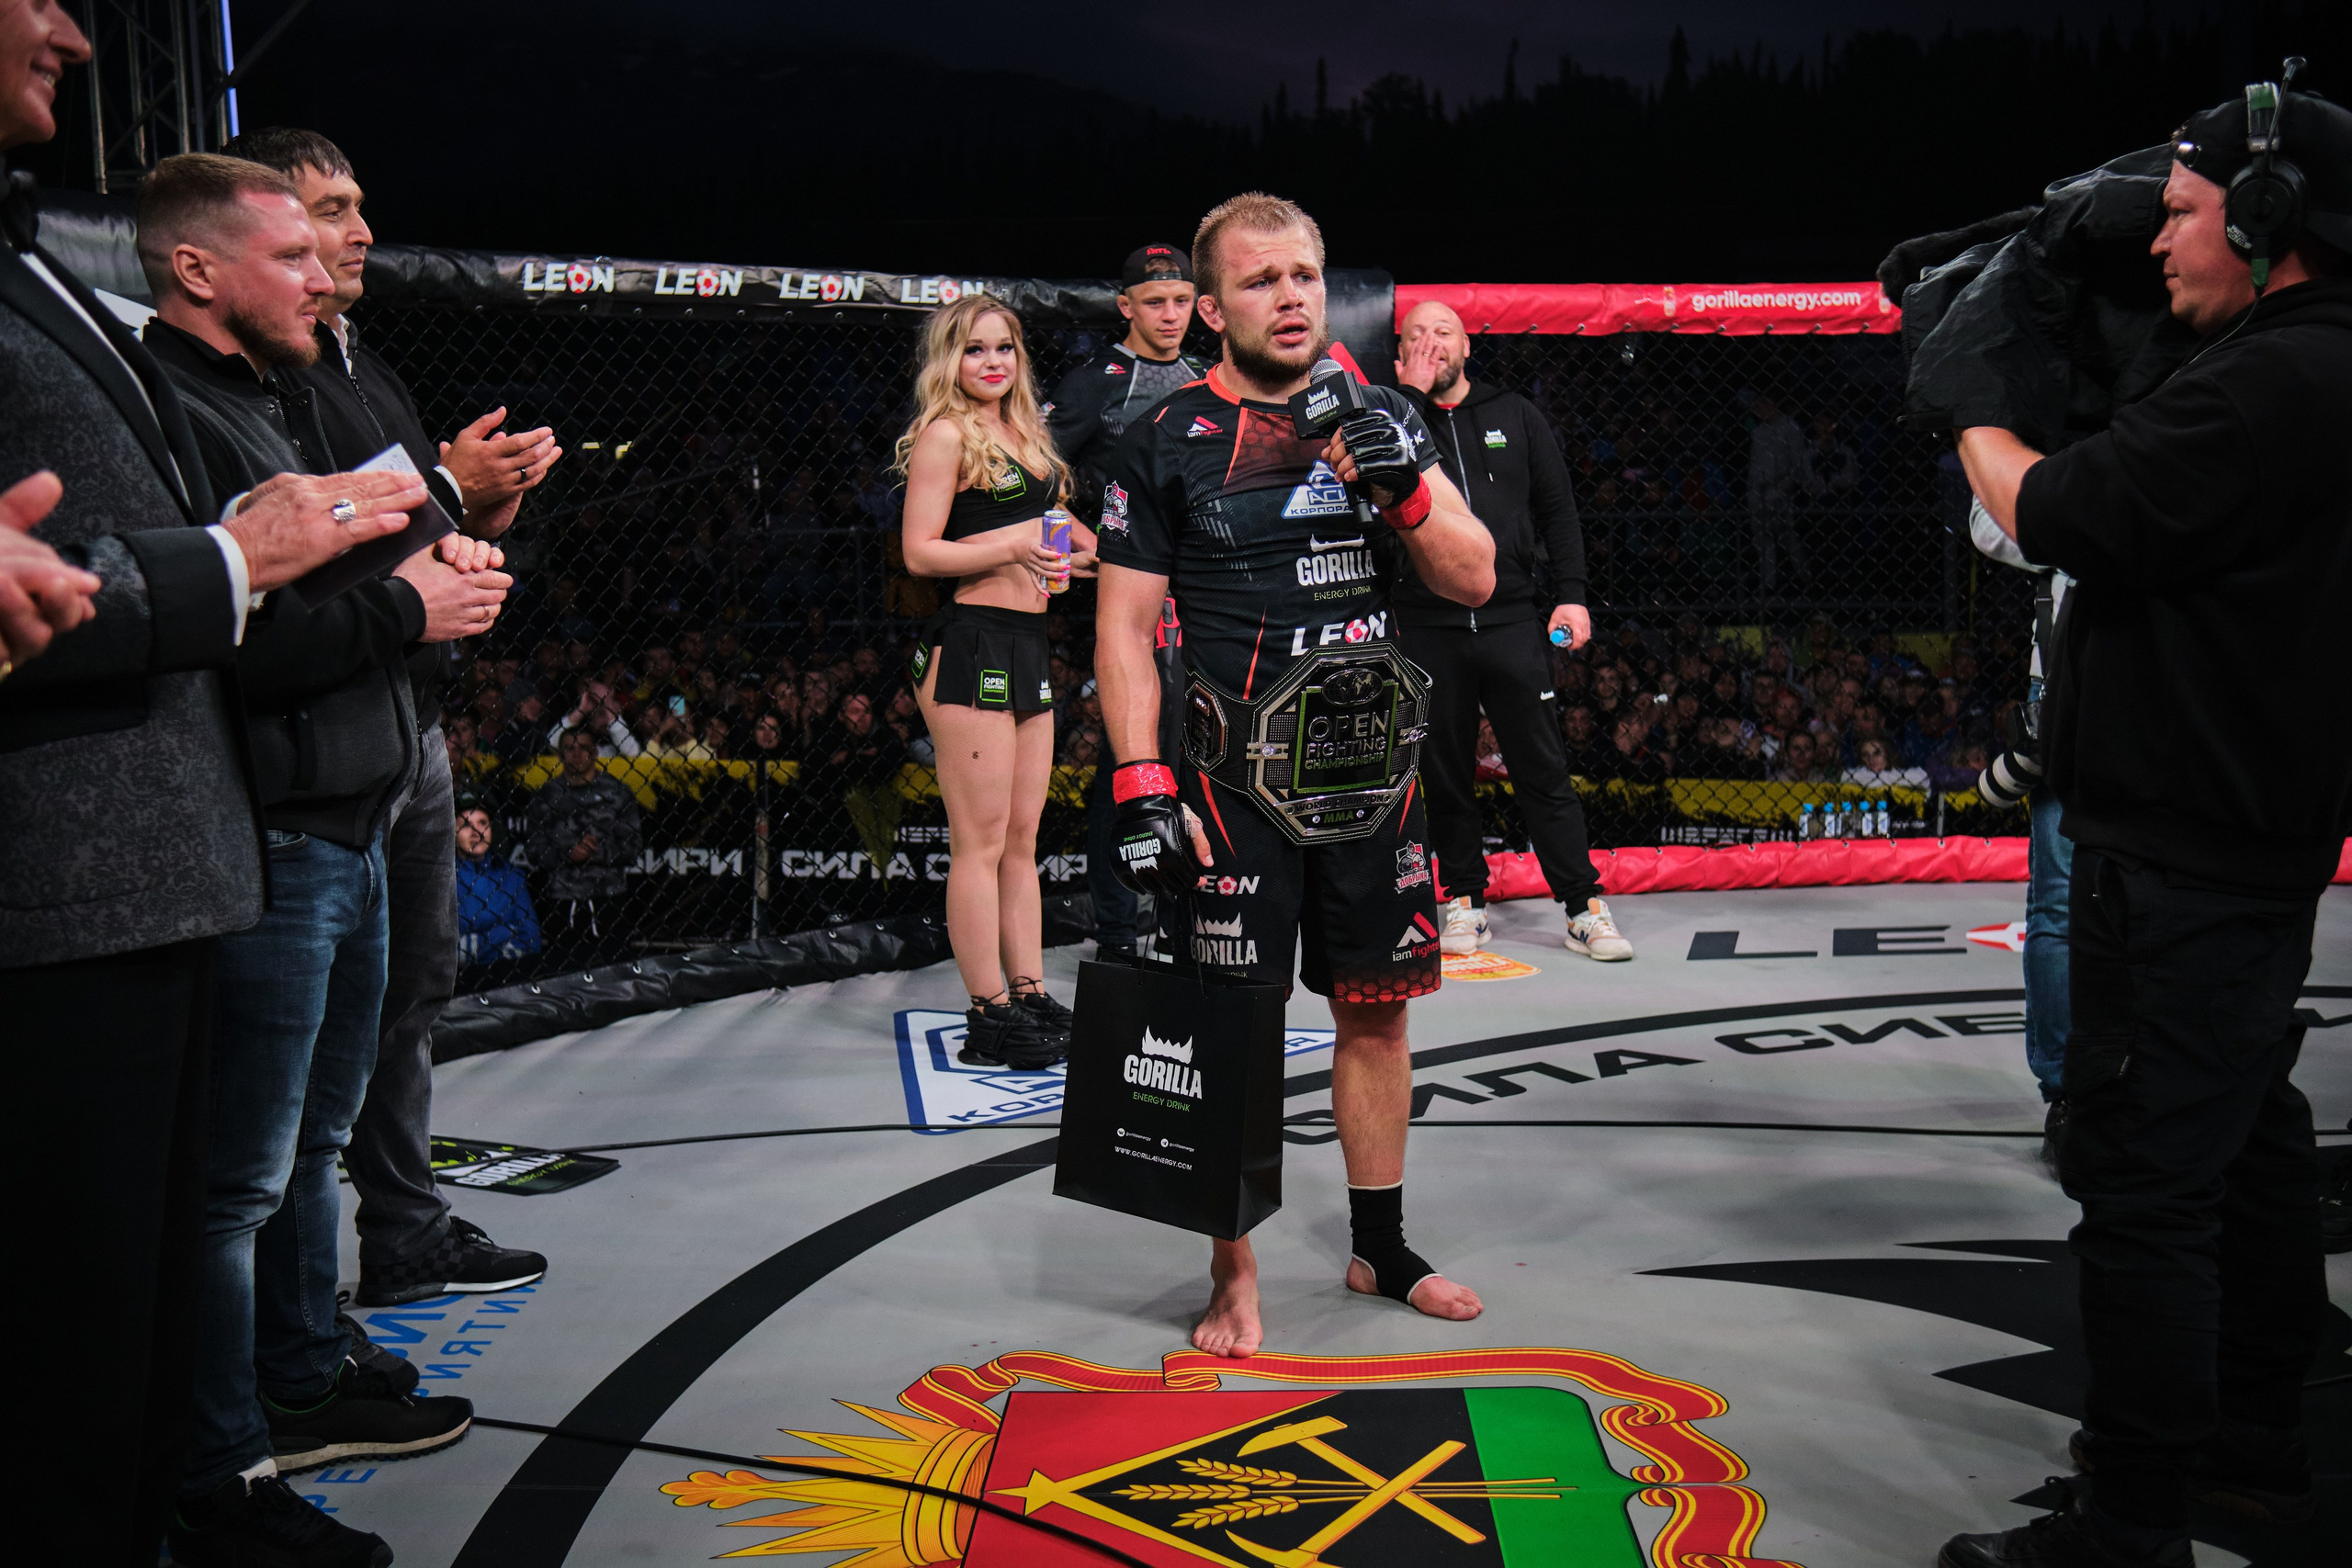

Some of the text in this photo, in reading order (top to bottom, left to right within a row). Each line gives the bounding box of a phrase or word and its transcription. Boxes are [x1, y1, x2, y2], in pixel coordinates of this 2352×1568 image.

[523, 263, 984, 306] LEON LEON LEON LEON
[1691, 290, 1860, 312] gorillaenergy.com
[1306, 394, 1340, 420] GORILLA
[1290, 504, 1353, 515] КОРПОРА
[1296, 550, 1377, 586] GORILLA
[1314, 585, 1372, 601] ENERGY DRINK
[984, 677, 1005, 685] OPEN
[1308, 710, 1389, 741] OPEN
[1306, 736, 1386, 758] FIGHTING
[1305, 751, 1385, 770] CHAMPIONSHIP
[1296, 800, 1331, 812] WORLD
[1323, 810, 1354, 824] MMA
[1119, 838, 1161, 862] GORILLA
[781, 849, 917, 881] СИЛА
[1196, 874, 1260, 896] EON
[1399, 872, 1428, 888] ДОБРЫНЯ
[1191, 934, 1259, 965] GORILLA
[1392, 940, 1441, 962] iamfighte
[1124, 1054, 1203, 1100] GORILLA
[1133, 1091, 1191, 1112] ENERGY DRINK
[1114, 1145, 1193, 1171] WWW.GORILLAENERGY.COM
